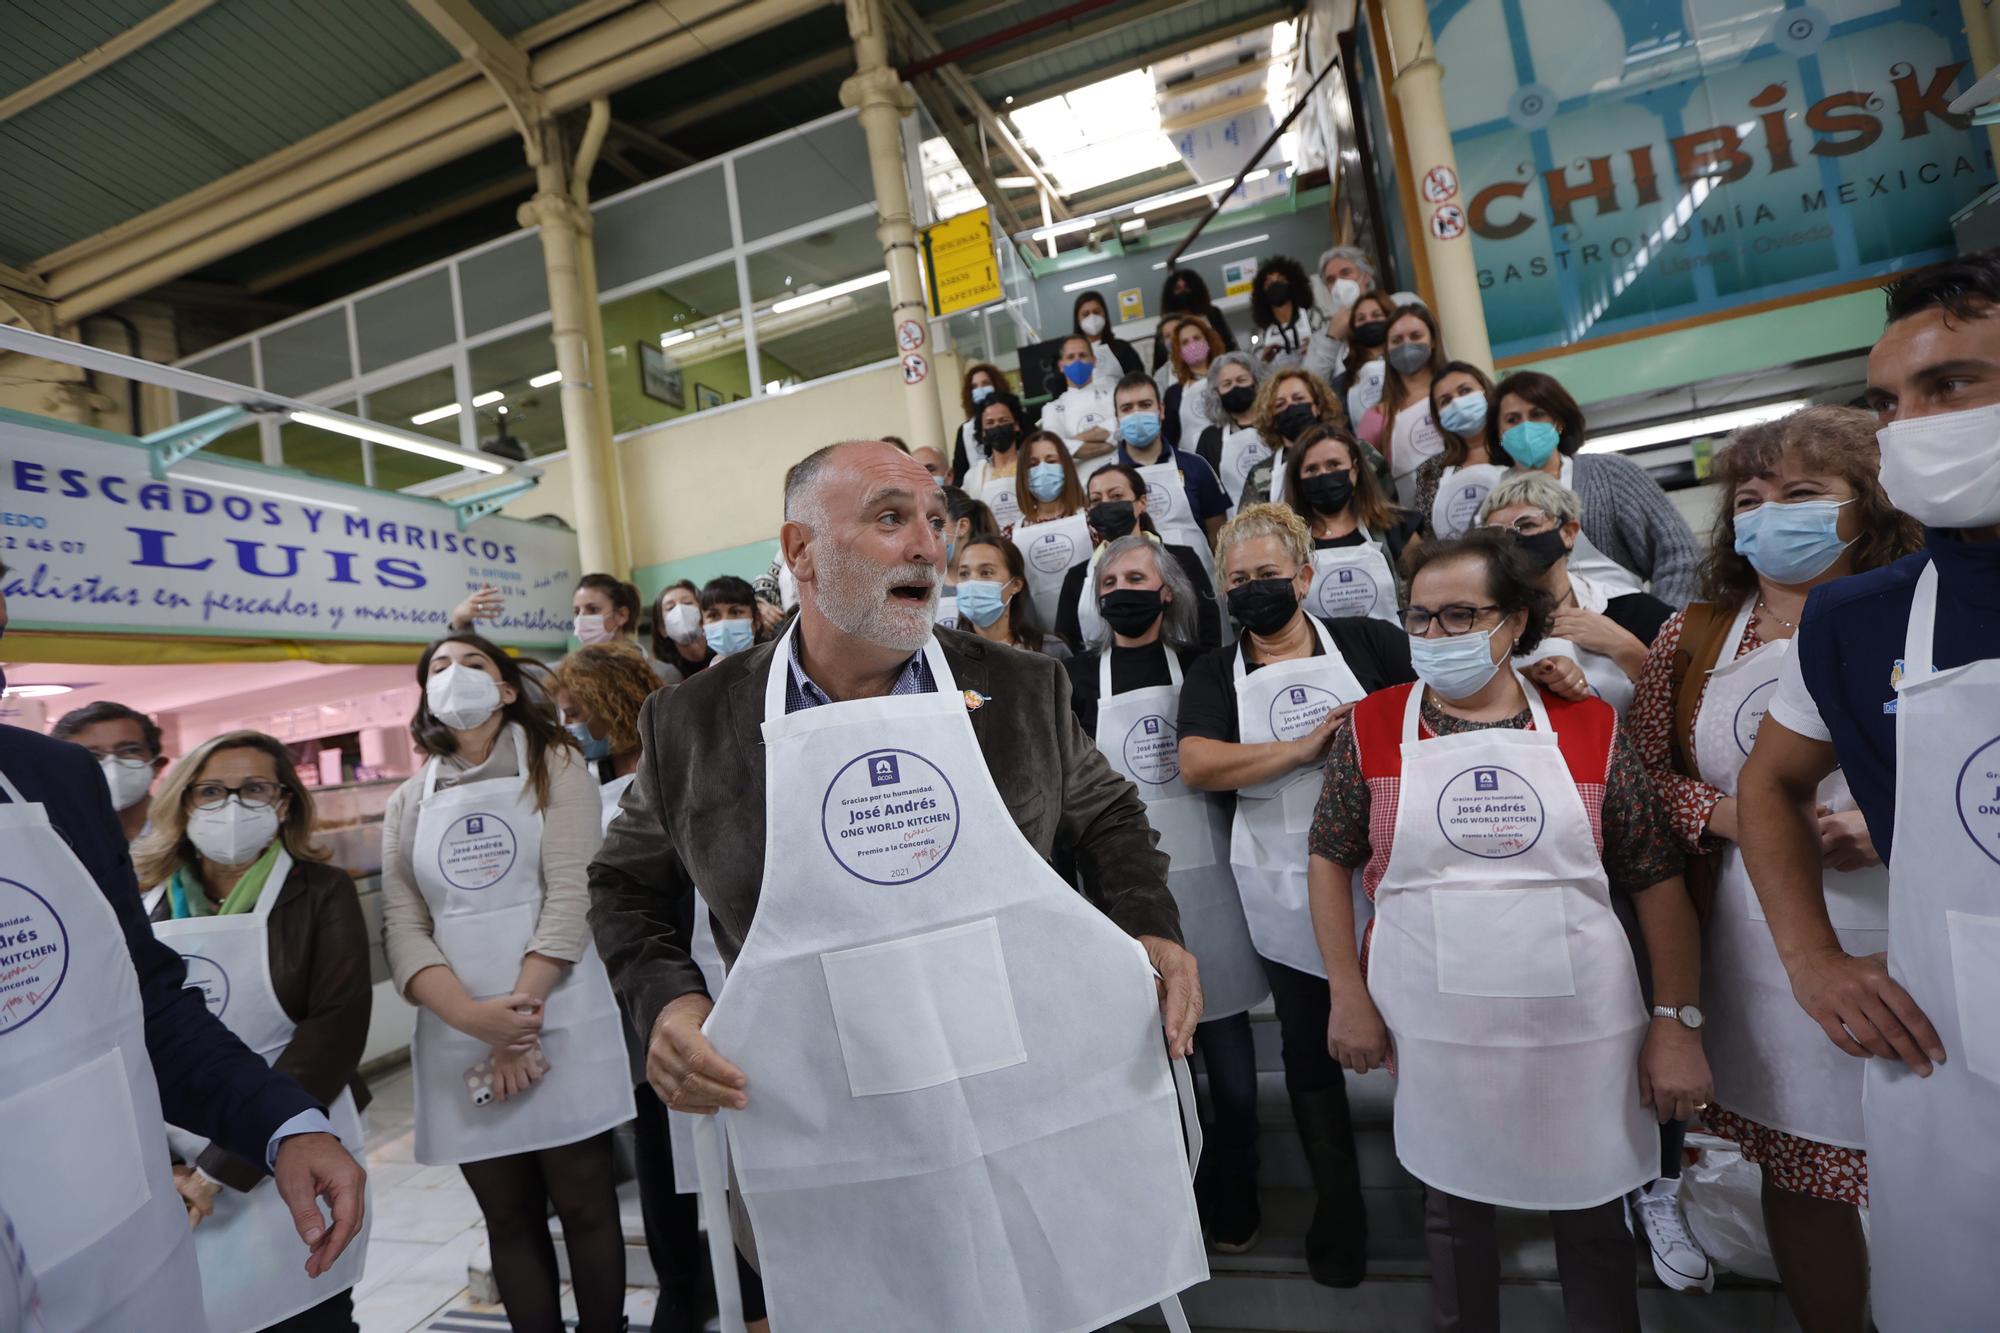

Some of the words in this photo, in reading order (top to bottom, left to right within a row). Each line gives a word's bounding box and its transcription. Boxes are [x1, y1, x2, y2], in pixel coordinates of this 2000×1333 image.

[301, 507, 322, 534] Y
[344, 514, 517, 563] MARISCOS
[125, 526, 427, 589] LUIS
[154, 588, 190, 608] en
[203, 588, 318, 621] pescados
[328, 605, 344, 630] y
[841, 796, 868, 806] Gracias
[869, 793, 882, 803] por
[849, 806, 881, 825] José
[884, 798, 937, 816] Andrés
[1457, 804, 1482, 815] José
[1485, 803, 1526, 813] Andrés
[840, 827, 864, 839] ONG
[866, 820, 905, 835] WORLD
[907, 813, 951, 828] KITCHEN
[1470, 816, 1500, 824] WORLD
[857, 847, 884, 857] Premio
[899, 838, 935, 849] Concordia
[891, 868, 910, 878] 2021
[0, 943, 58, 967] KITCHEN
